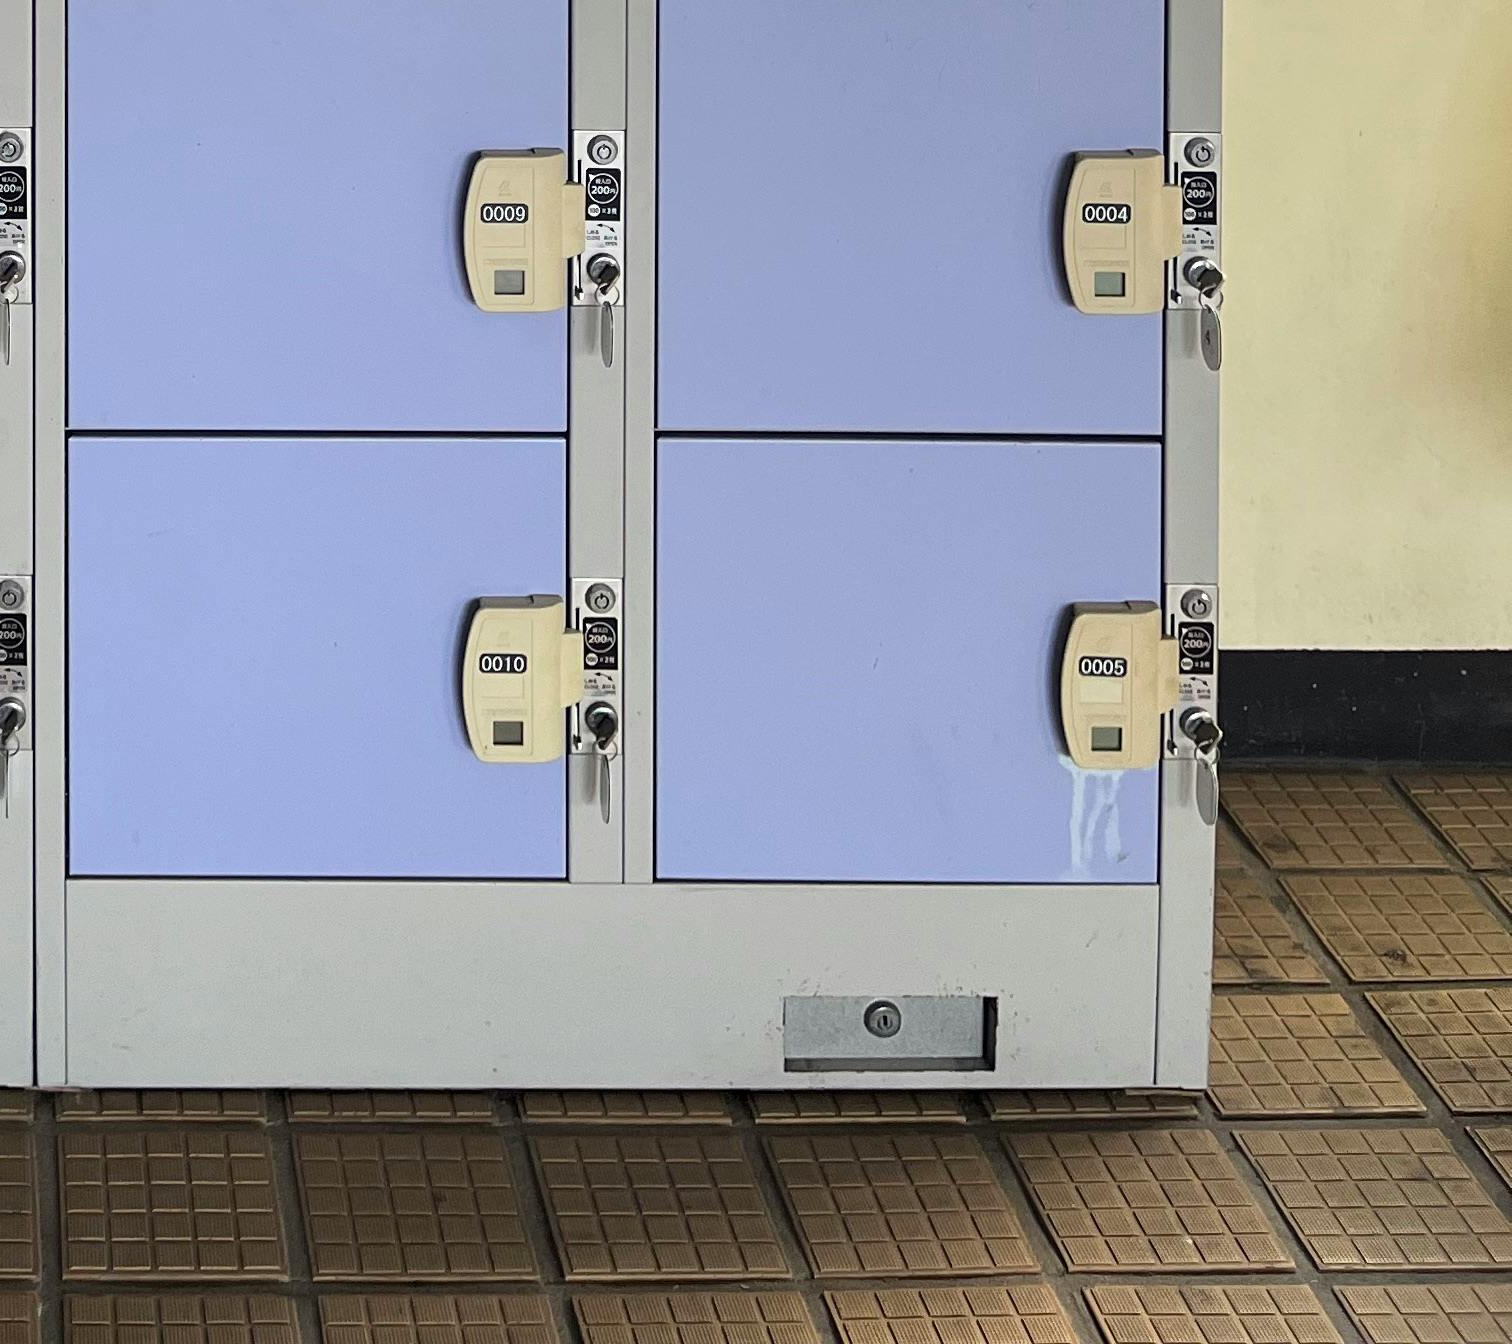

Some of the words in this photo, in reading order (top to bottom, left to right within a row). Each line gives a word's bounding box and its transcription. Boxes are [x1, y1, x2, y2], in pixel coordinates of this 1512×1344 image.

[483, 205, 526, 222] 0009
[1084, 206, 1127, 222] 0004
[481, 656, 524, 672] 0010
[1081, 658, 1125, 675] 0005
